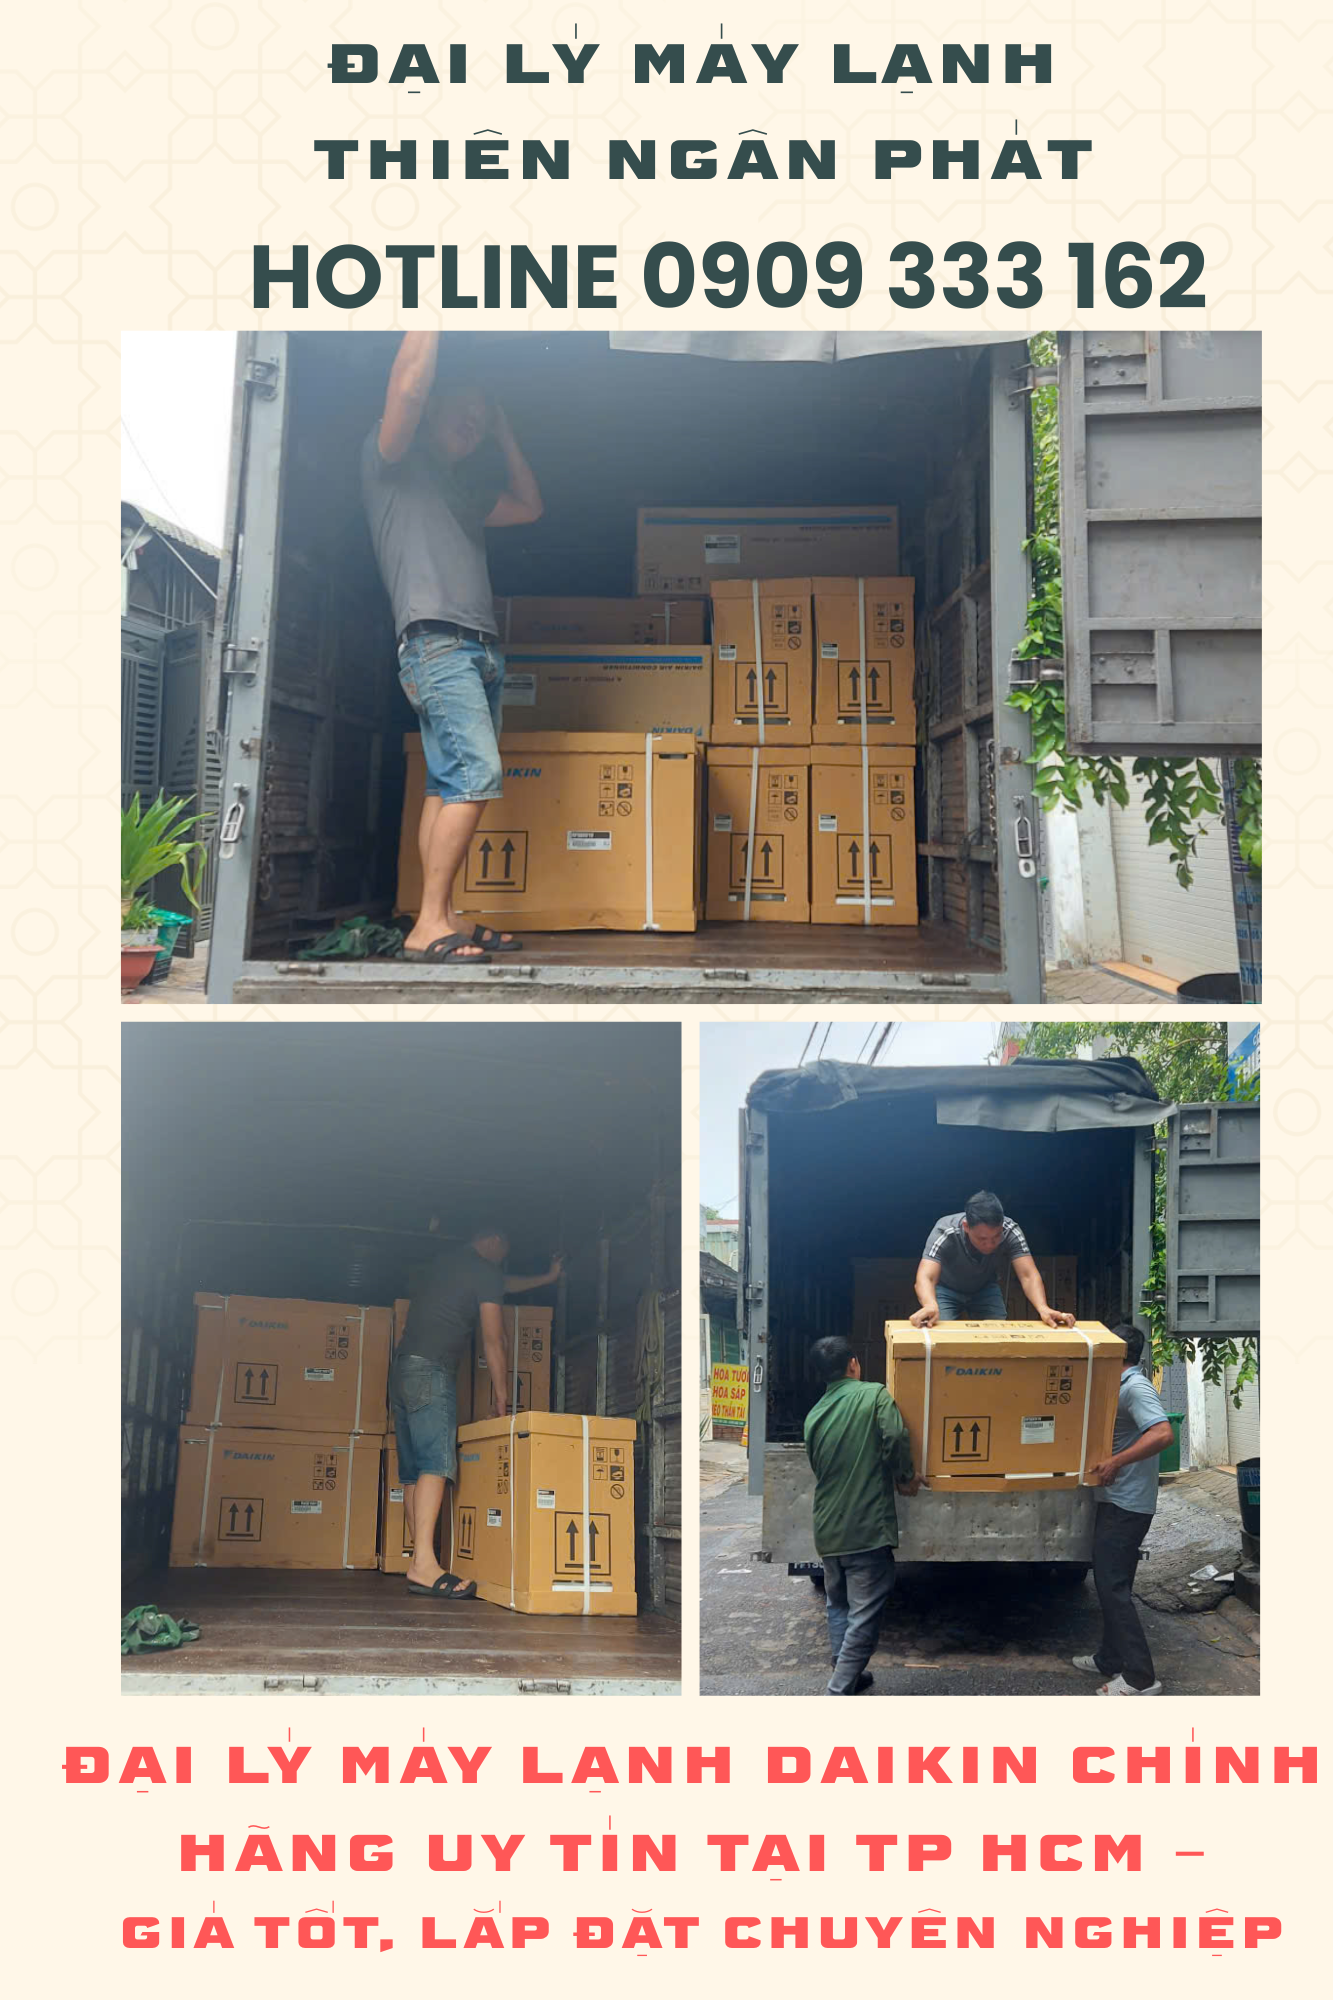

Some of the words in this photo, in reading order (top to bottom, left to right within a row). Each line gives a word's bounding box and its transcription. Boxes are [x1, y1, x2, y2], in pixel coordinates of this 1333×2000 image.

[503, 767, 542, 778] IKIN
[713, 1367, 729, 1381] HOA
[956, 1368, 1002, 1376] DAIKIN
[712, 1385, 728, 1399] HOA
[233, 1451, 275, 1461] DAIKIN
